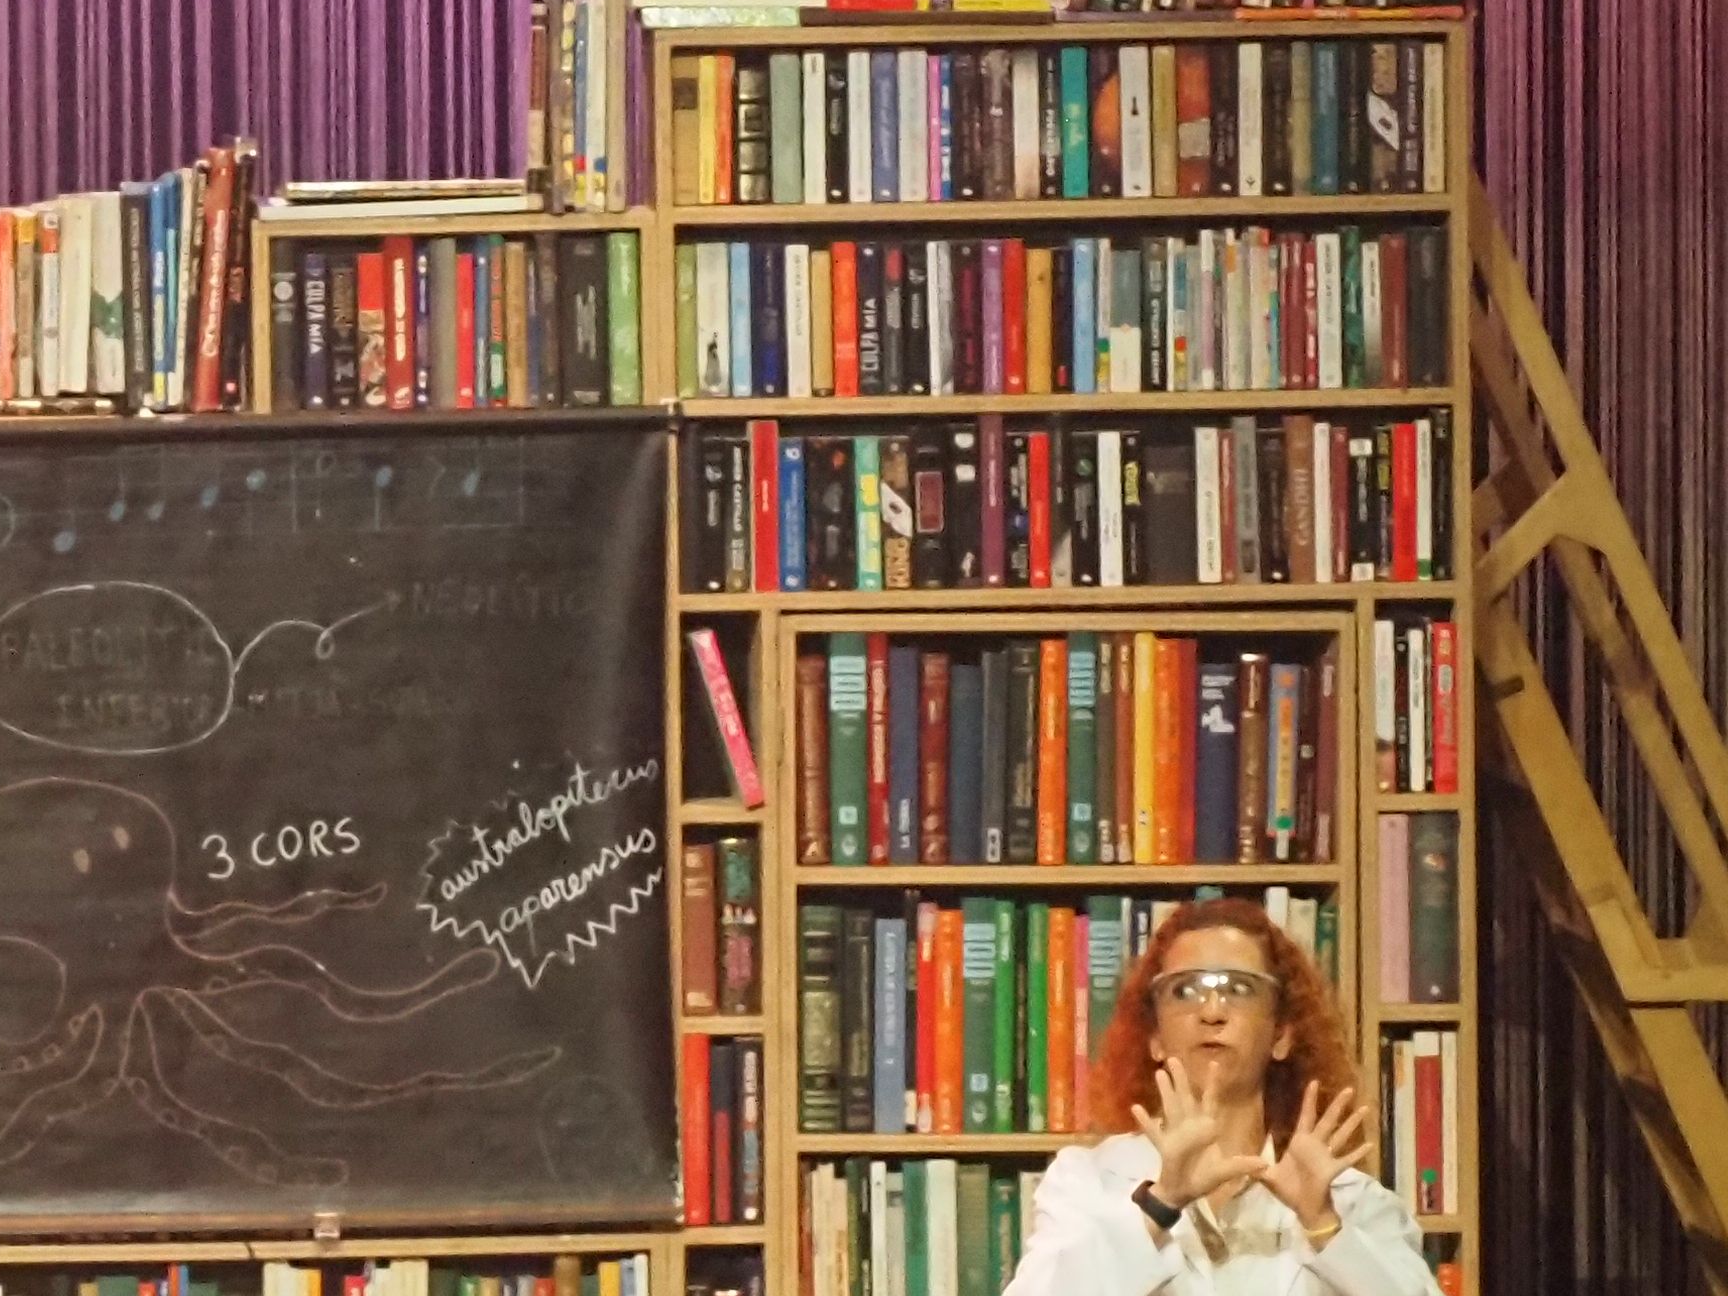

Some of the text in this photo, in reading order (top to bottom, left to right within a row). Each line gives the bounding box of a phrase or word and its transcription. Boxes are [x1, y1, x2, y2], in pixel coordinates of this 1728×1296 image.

[305, 280, 326, 321] CULPA
[860, 331, 879, 371] CULPA
[1292, 468, 1311, 546] GANDHI
[201, 816, 361, 880] 3 CORS
